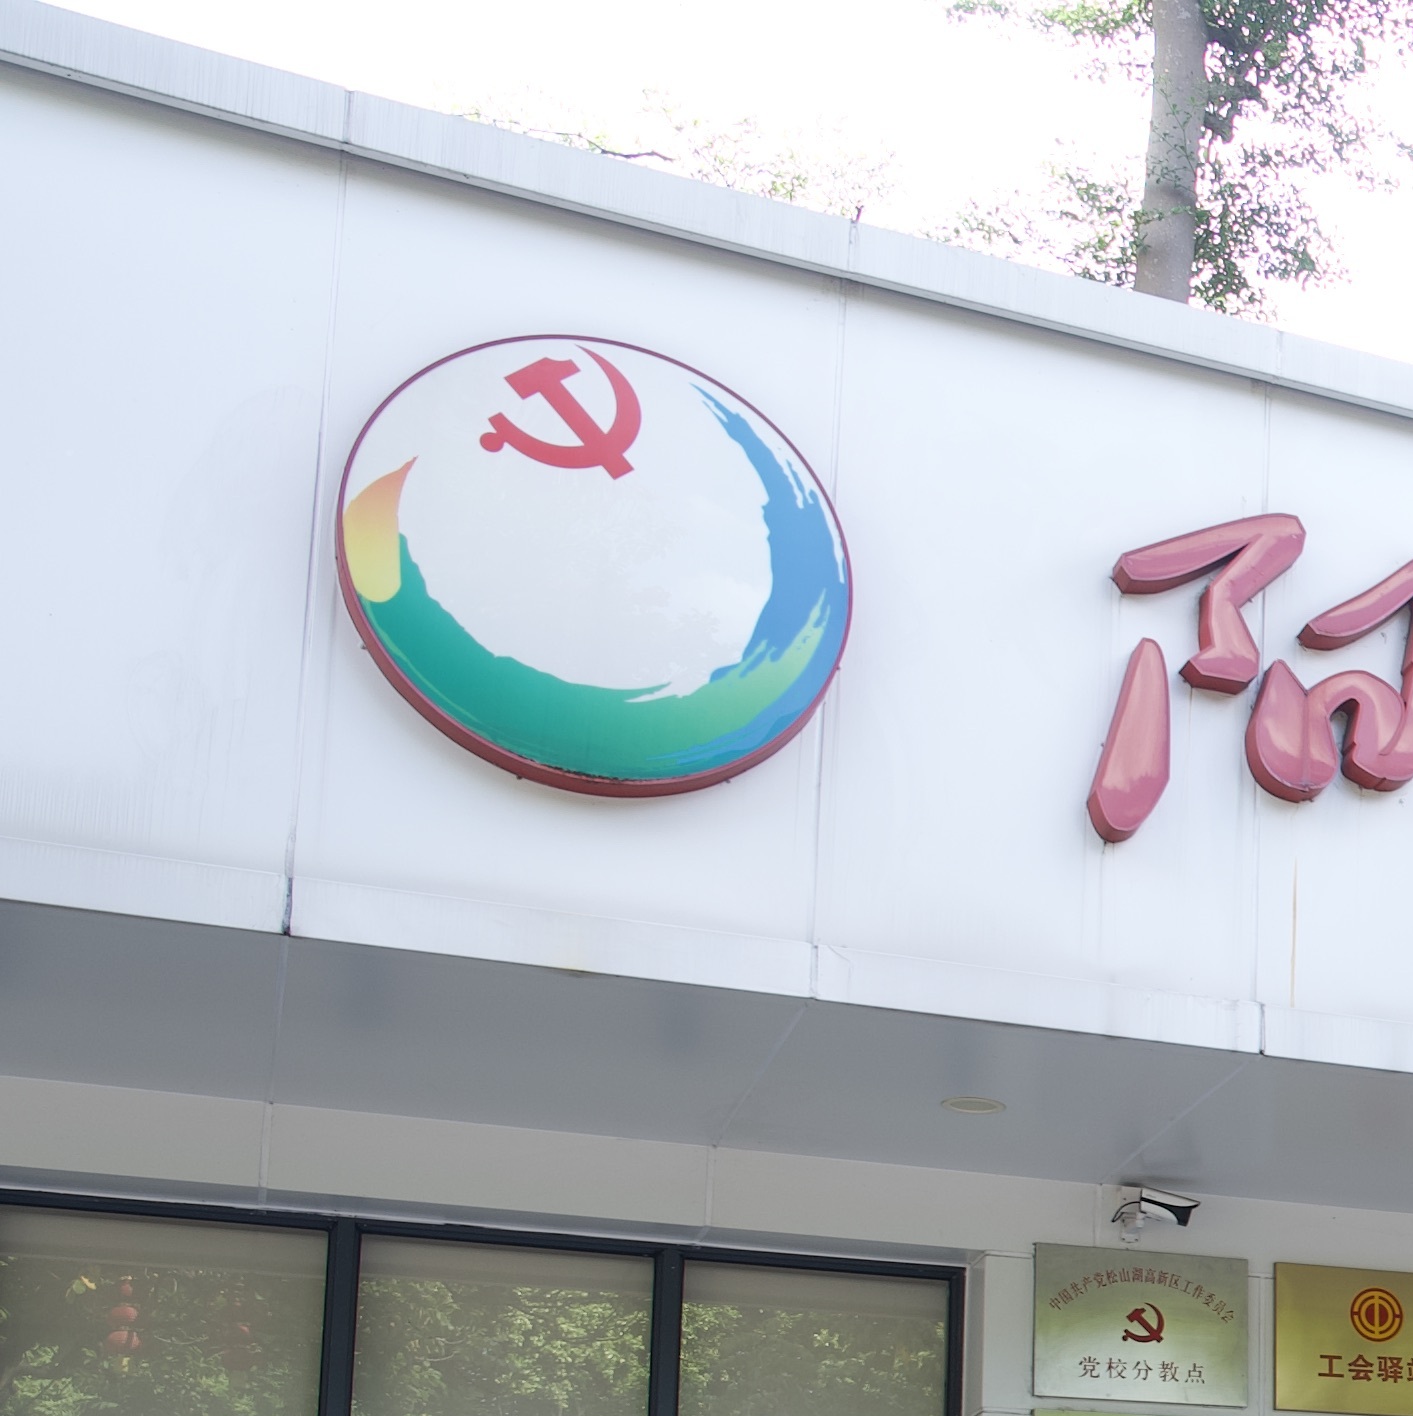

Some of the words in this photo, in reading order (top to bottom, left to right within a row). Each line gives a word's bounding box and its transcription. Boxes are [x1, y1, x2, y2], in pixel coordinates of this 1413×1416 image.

[1079, 1355, 1206, 1385] 党校分教点
